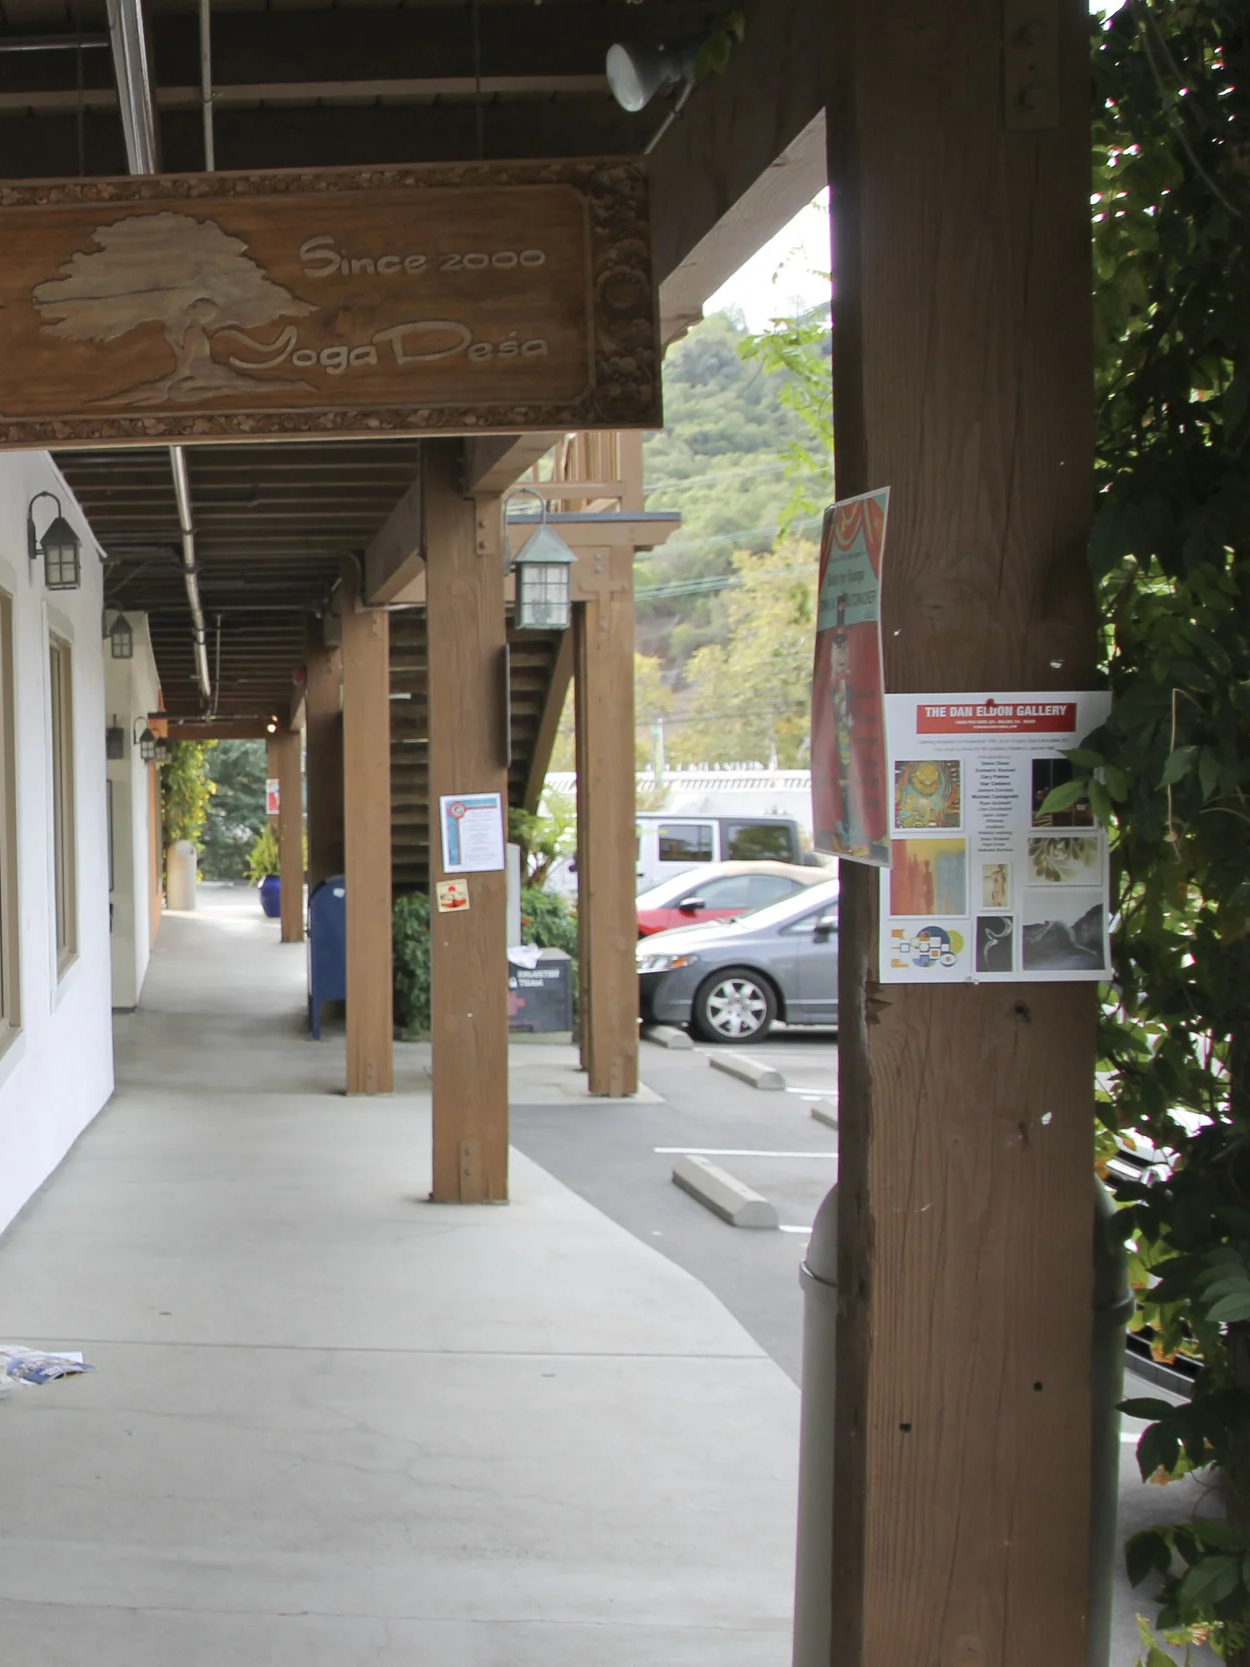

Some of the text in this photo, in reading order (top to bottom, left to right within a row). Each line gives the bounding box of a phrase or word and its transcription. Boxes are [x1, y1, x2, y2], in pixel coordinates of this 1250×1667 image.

[298, 234, 546, 278] Since 2000
[211, 323, 378, 375] Yoga
[925, 706, 947, 718] THE
[950, 706, 973, 717] DAN
[1016, 705, 1067, 716] GALLERY
[517, 978, 544, 988] TEAM
